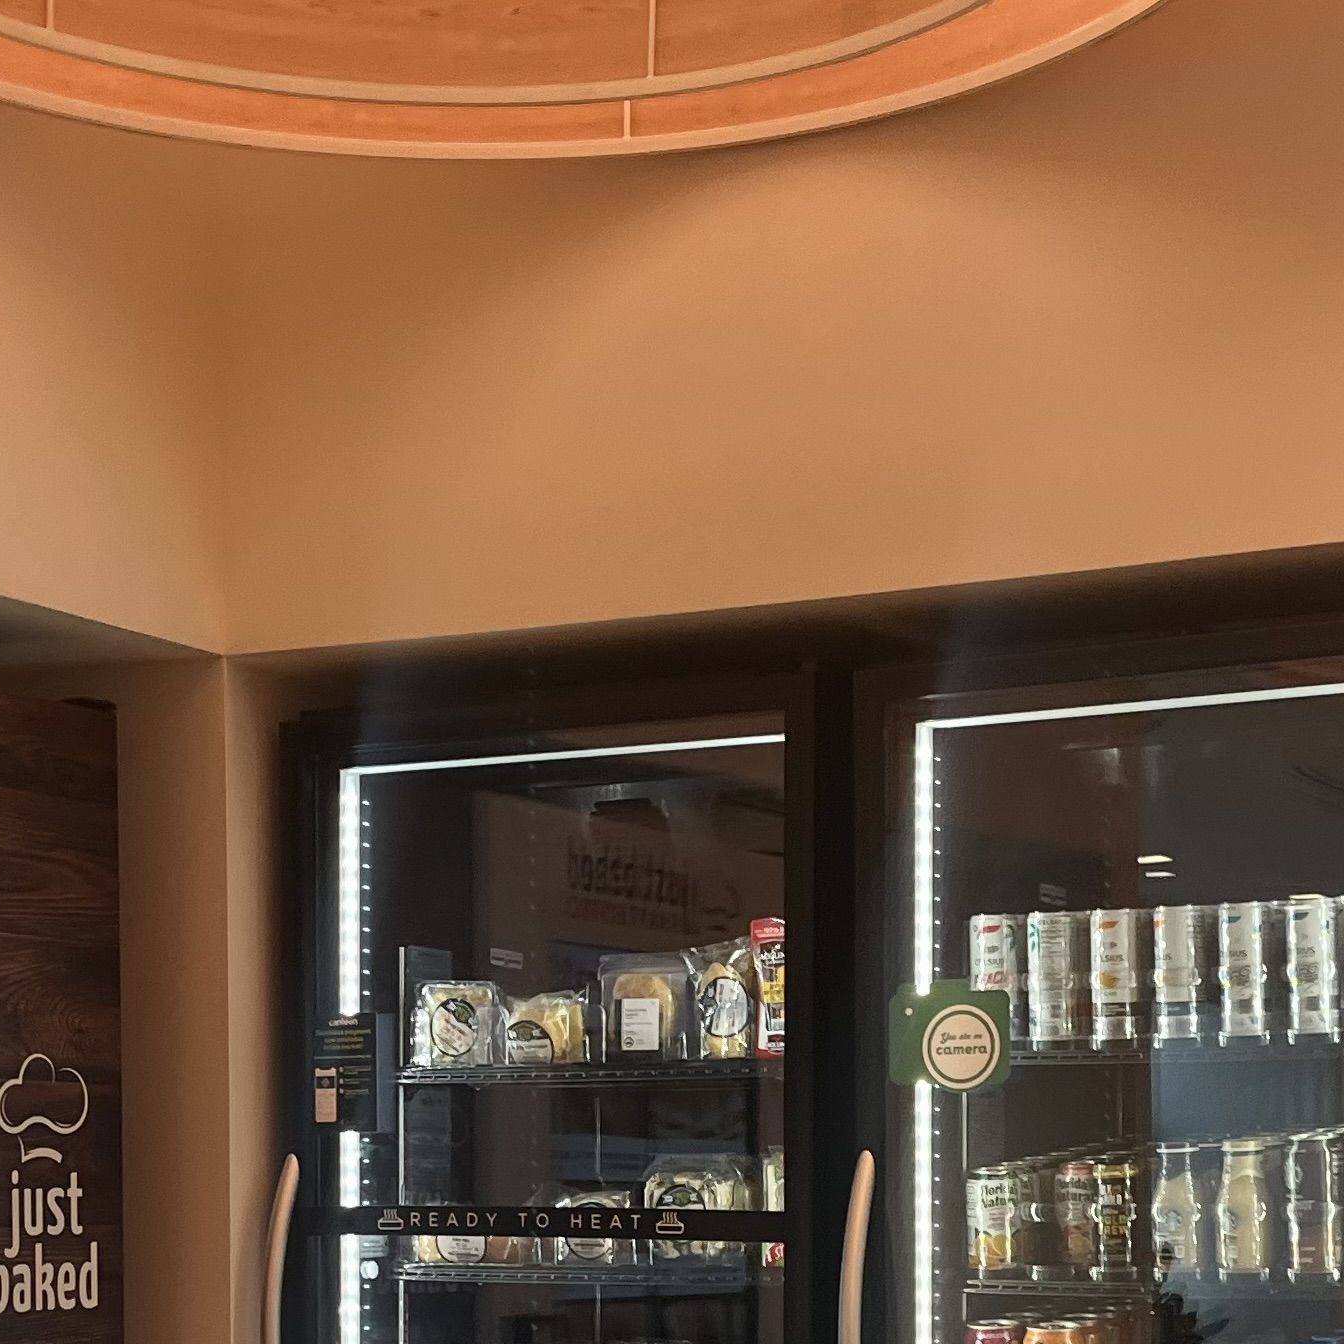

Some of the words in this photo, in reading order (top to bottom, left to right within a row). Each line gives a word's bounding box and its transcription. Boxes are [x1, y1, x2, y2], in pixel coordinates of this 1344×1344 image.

[936, 1045, 988, 1055] camera
[4, 1169, 84, 1259] just
[410, 1211, 498, 1229] READY
[519, 1212, 550, 1229] TO
[570, 1213, 641, 1231] HEAT
